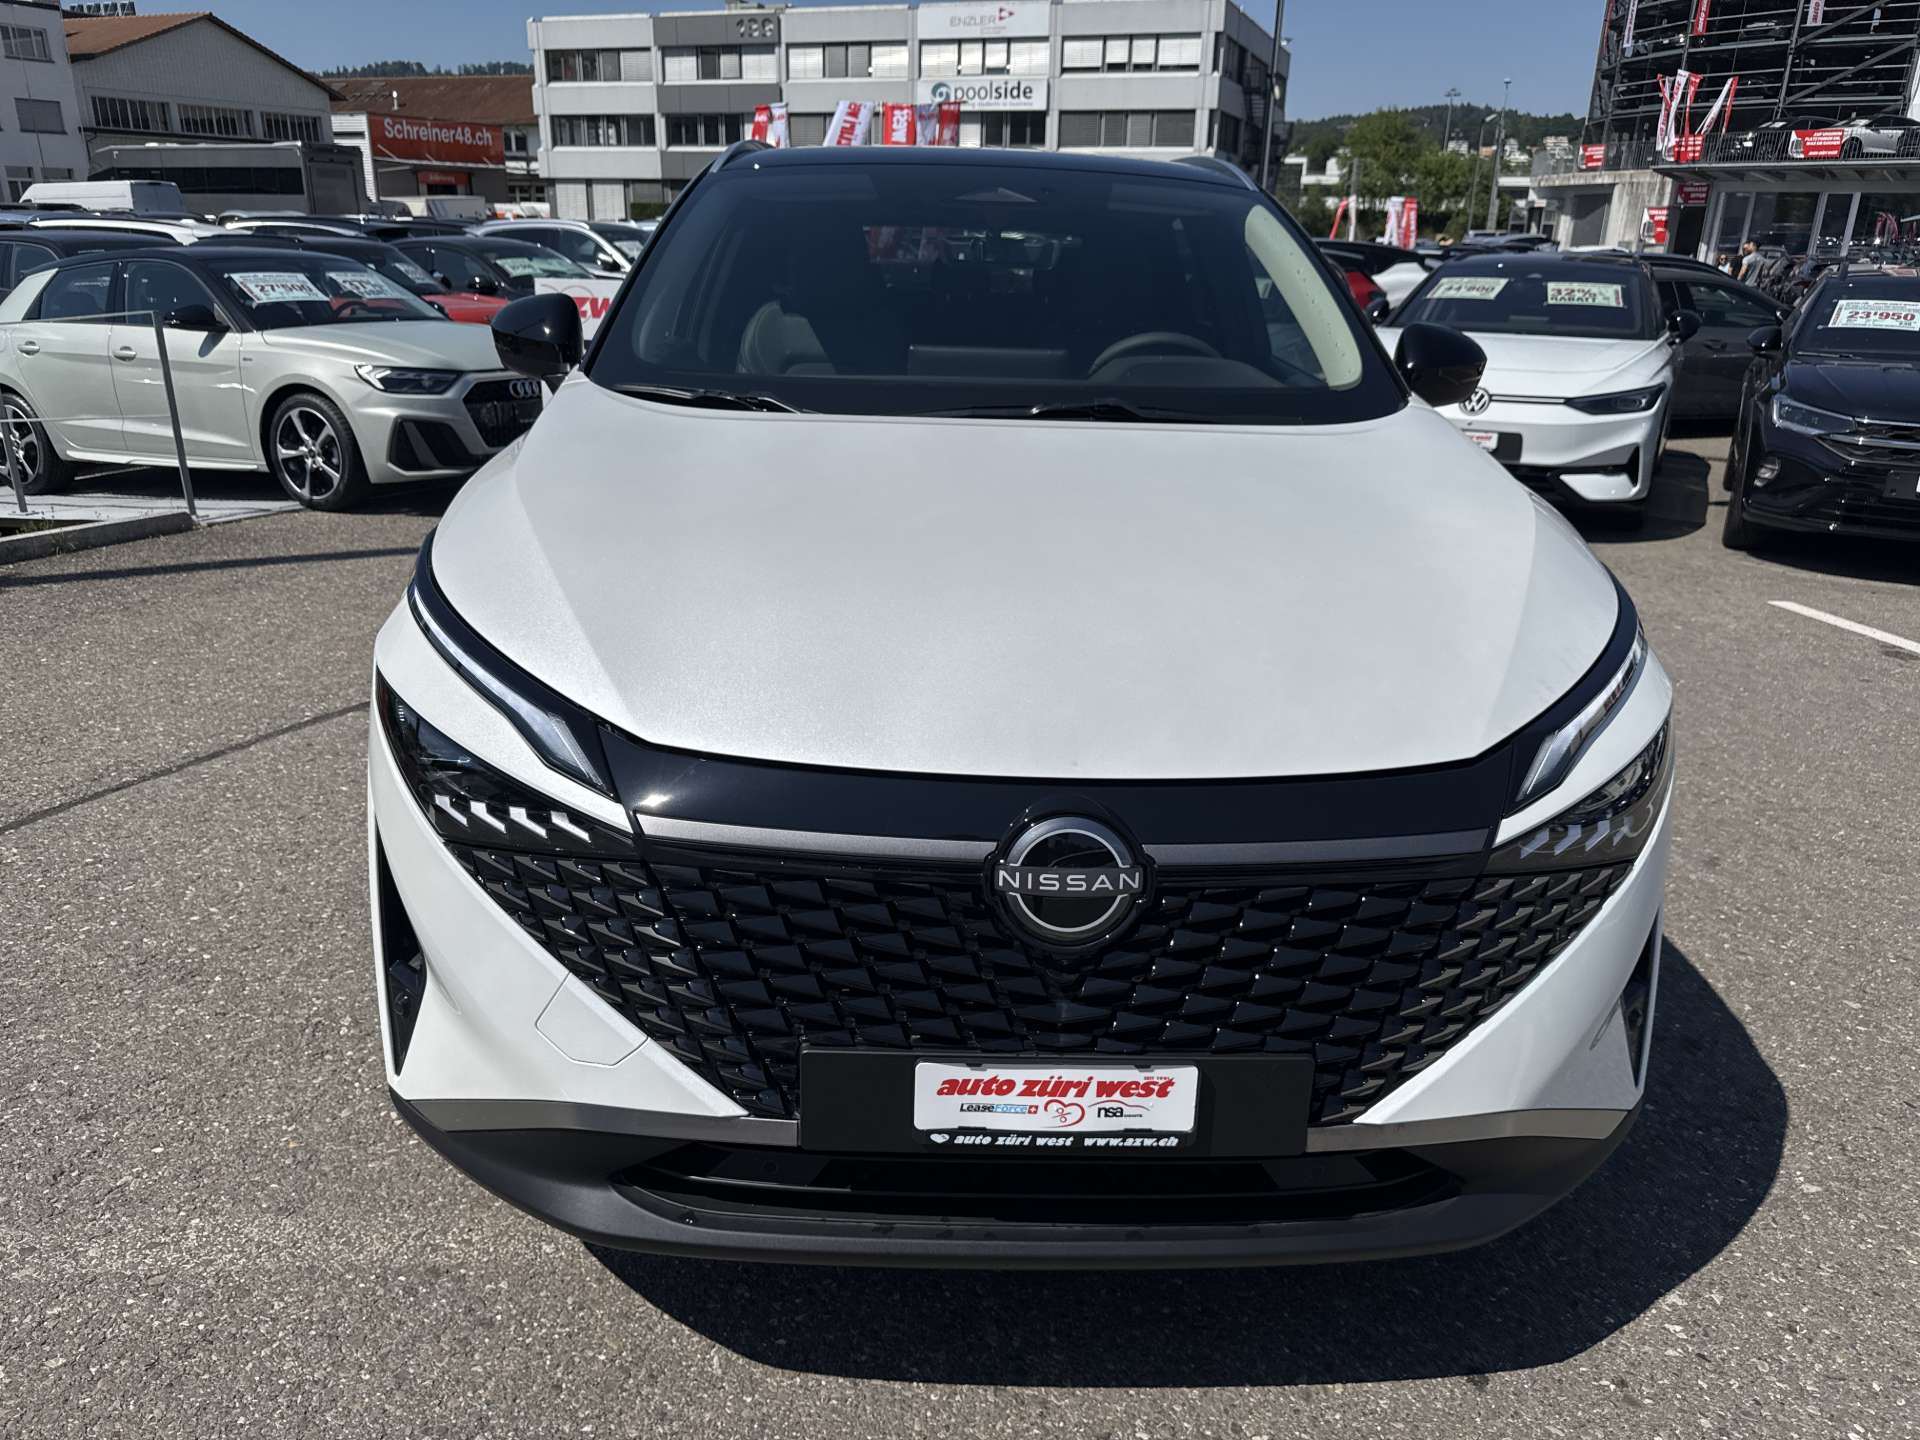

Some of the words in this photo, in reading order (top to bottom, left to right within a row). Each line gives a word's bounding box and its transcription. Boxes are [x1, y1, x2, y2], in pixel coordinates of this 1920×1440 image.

[950, 15, 997, 27] ENZLER
[954, 81, 1033, 101] poolside
[384, 117, 493, 146] Schreiner48.ch
[1848, 311, 1916, 321] 23'950
[998, 869, 1140, 891] NISSAN
[936, 1074, 1016, 1096] auto
[1016, 1075, 1094, 1098] züri
[1095, 1076, 1175, 1098] west
[960, 1103, 1028, 1114] LeaseForce
[1097, 1106, 1124, 1118] nsa
[953, 1134, 992, 1145] auto
[994, 1134, 1032, 1146] züri
[1035, 1135, 1074, 1147] west
[1083, 1136, 1180, 1147] www.azw.ch
